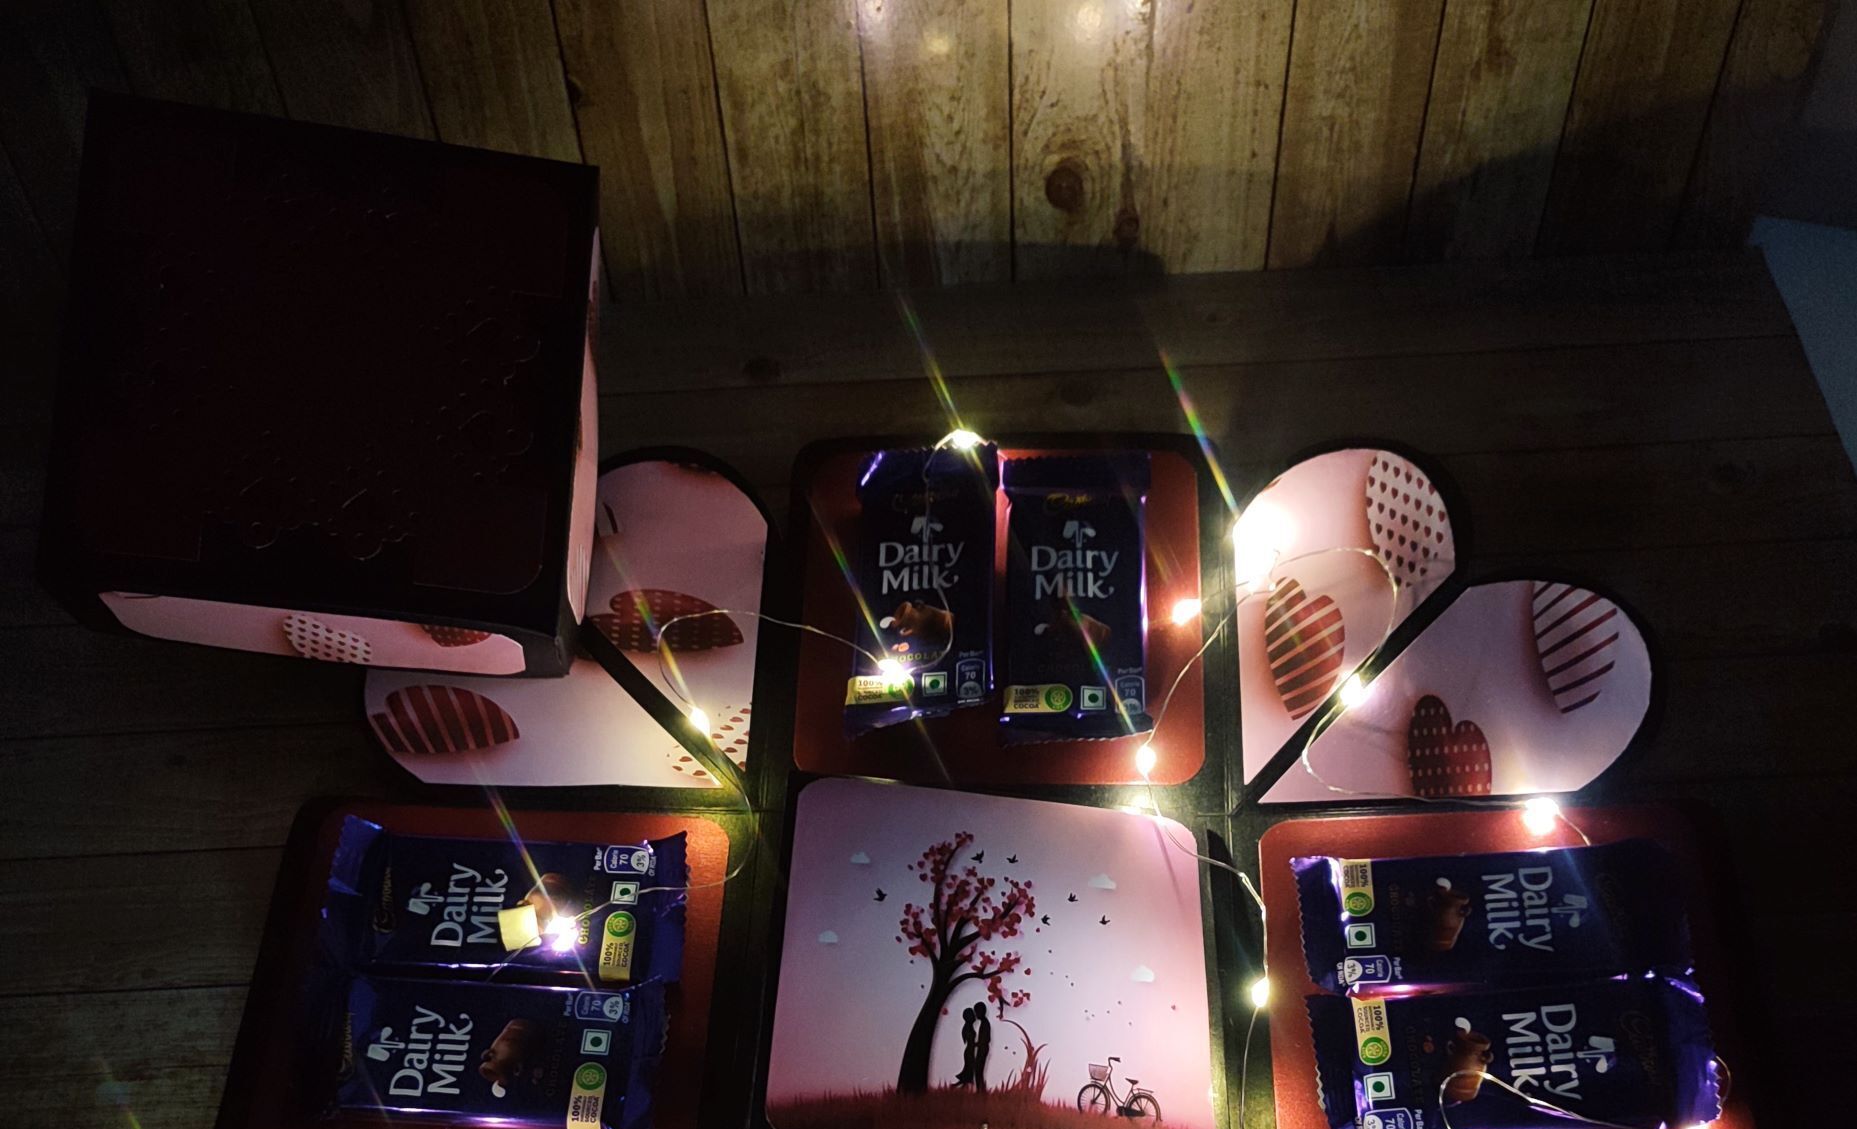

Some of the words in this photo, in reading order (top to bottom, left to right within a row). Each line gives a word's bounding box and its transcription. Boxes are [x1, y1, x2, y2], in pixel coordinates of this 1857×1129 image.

[879, 541, 965, 568] Dairy
[1031, 546, 1119, 577] Dairy
[882, 565, 959, 595] Milk
[1035, 571, 1115, 600] Milk
[593, 861, 601, 871] Per
[610, 850, 618, 868] Calorie
[620, 854, 628, 864] 70
[637, 855, 646, 867] 3%
[1360, 864, 1368, 887] 100%
[430, 862, 482, 947] Dairy
[466, 868, 509, 943] Milk
[1481, 873, 1521, 950] Milk
[1518, 866, 1554, 952] Dairy
[603, 942, 613, 965] 100%
[1347, 964, 1356, 977] 3%
[1365, 963, 1374, 974] 70
[591, 1000, 601, 1012] 70
[608, 1001, 620, 1015] 3%
[1374, 1006, 1383, 1030] 100%
[388, 1005, 445, 1097] Dairy
[427, 1013, 473, 1094] Milk
[1501, 1012, 1546, 1098] Milk
[1540, 1003, 1583, 1100] Dairy
[571, 1095, 582, 1122] 100%
[590, 1096, 599, 1123] COCOA
[1414, 1109, 1423, 1121] Per
[1385, 1118, 1395, 1129] 70
